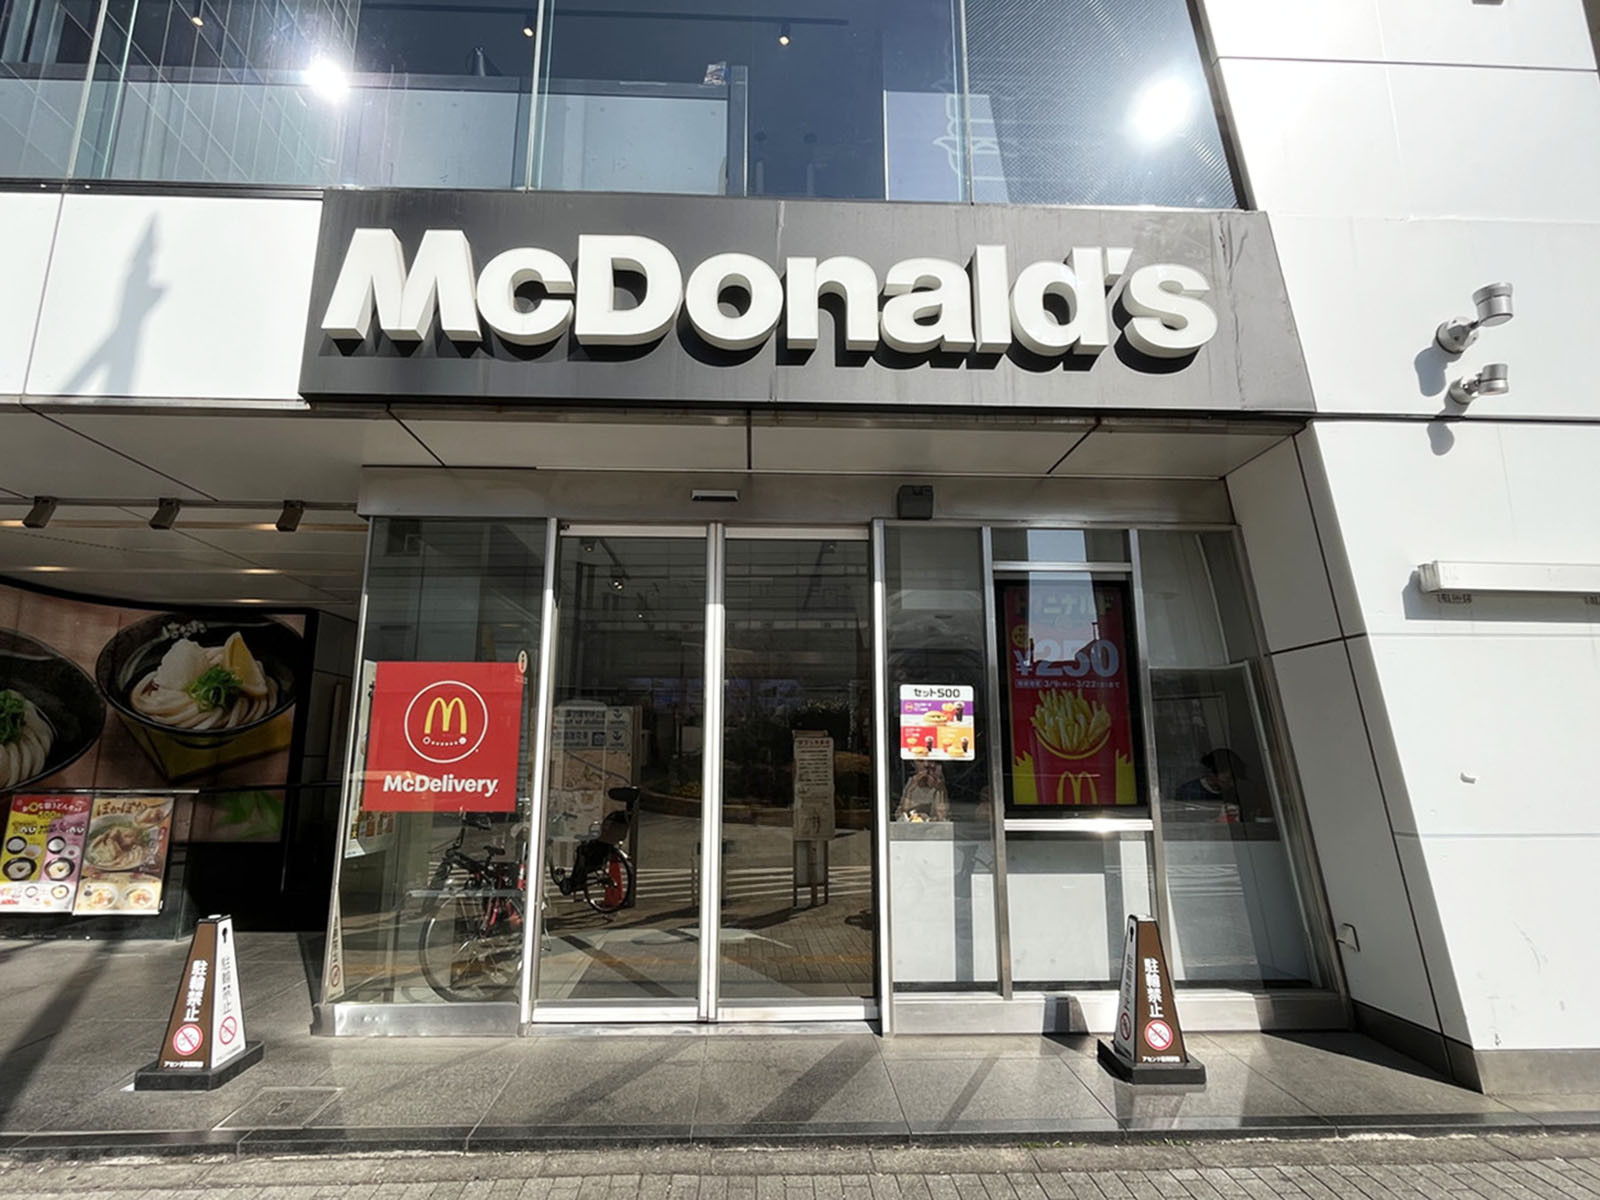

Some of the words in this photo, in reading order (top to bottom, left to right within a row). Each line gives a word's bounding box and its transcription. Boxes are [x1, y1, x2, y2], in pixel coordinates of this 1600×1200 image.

[321, 228, 1218, 358] McDonald's
[913, 688, 960, 698] セット500
[383, 774, 498, 797] McDelivery
[183, 959, 208, 1022] 駐輪禁止
[1143, 957, 1164, 1018] 駐輪禁止
